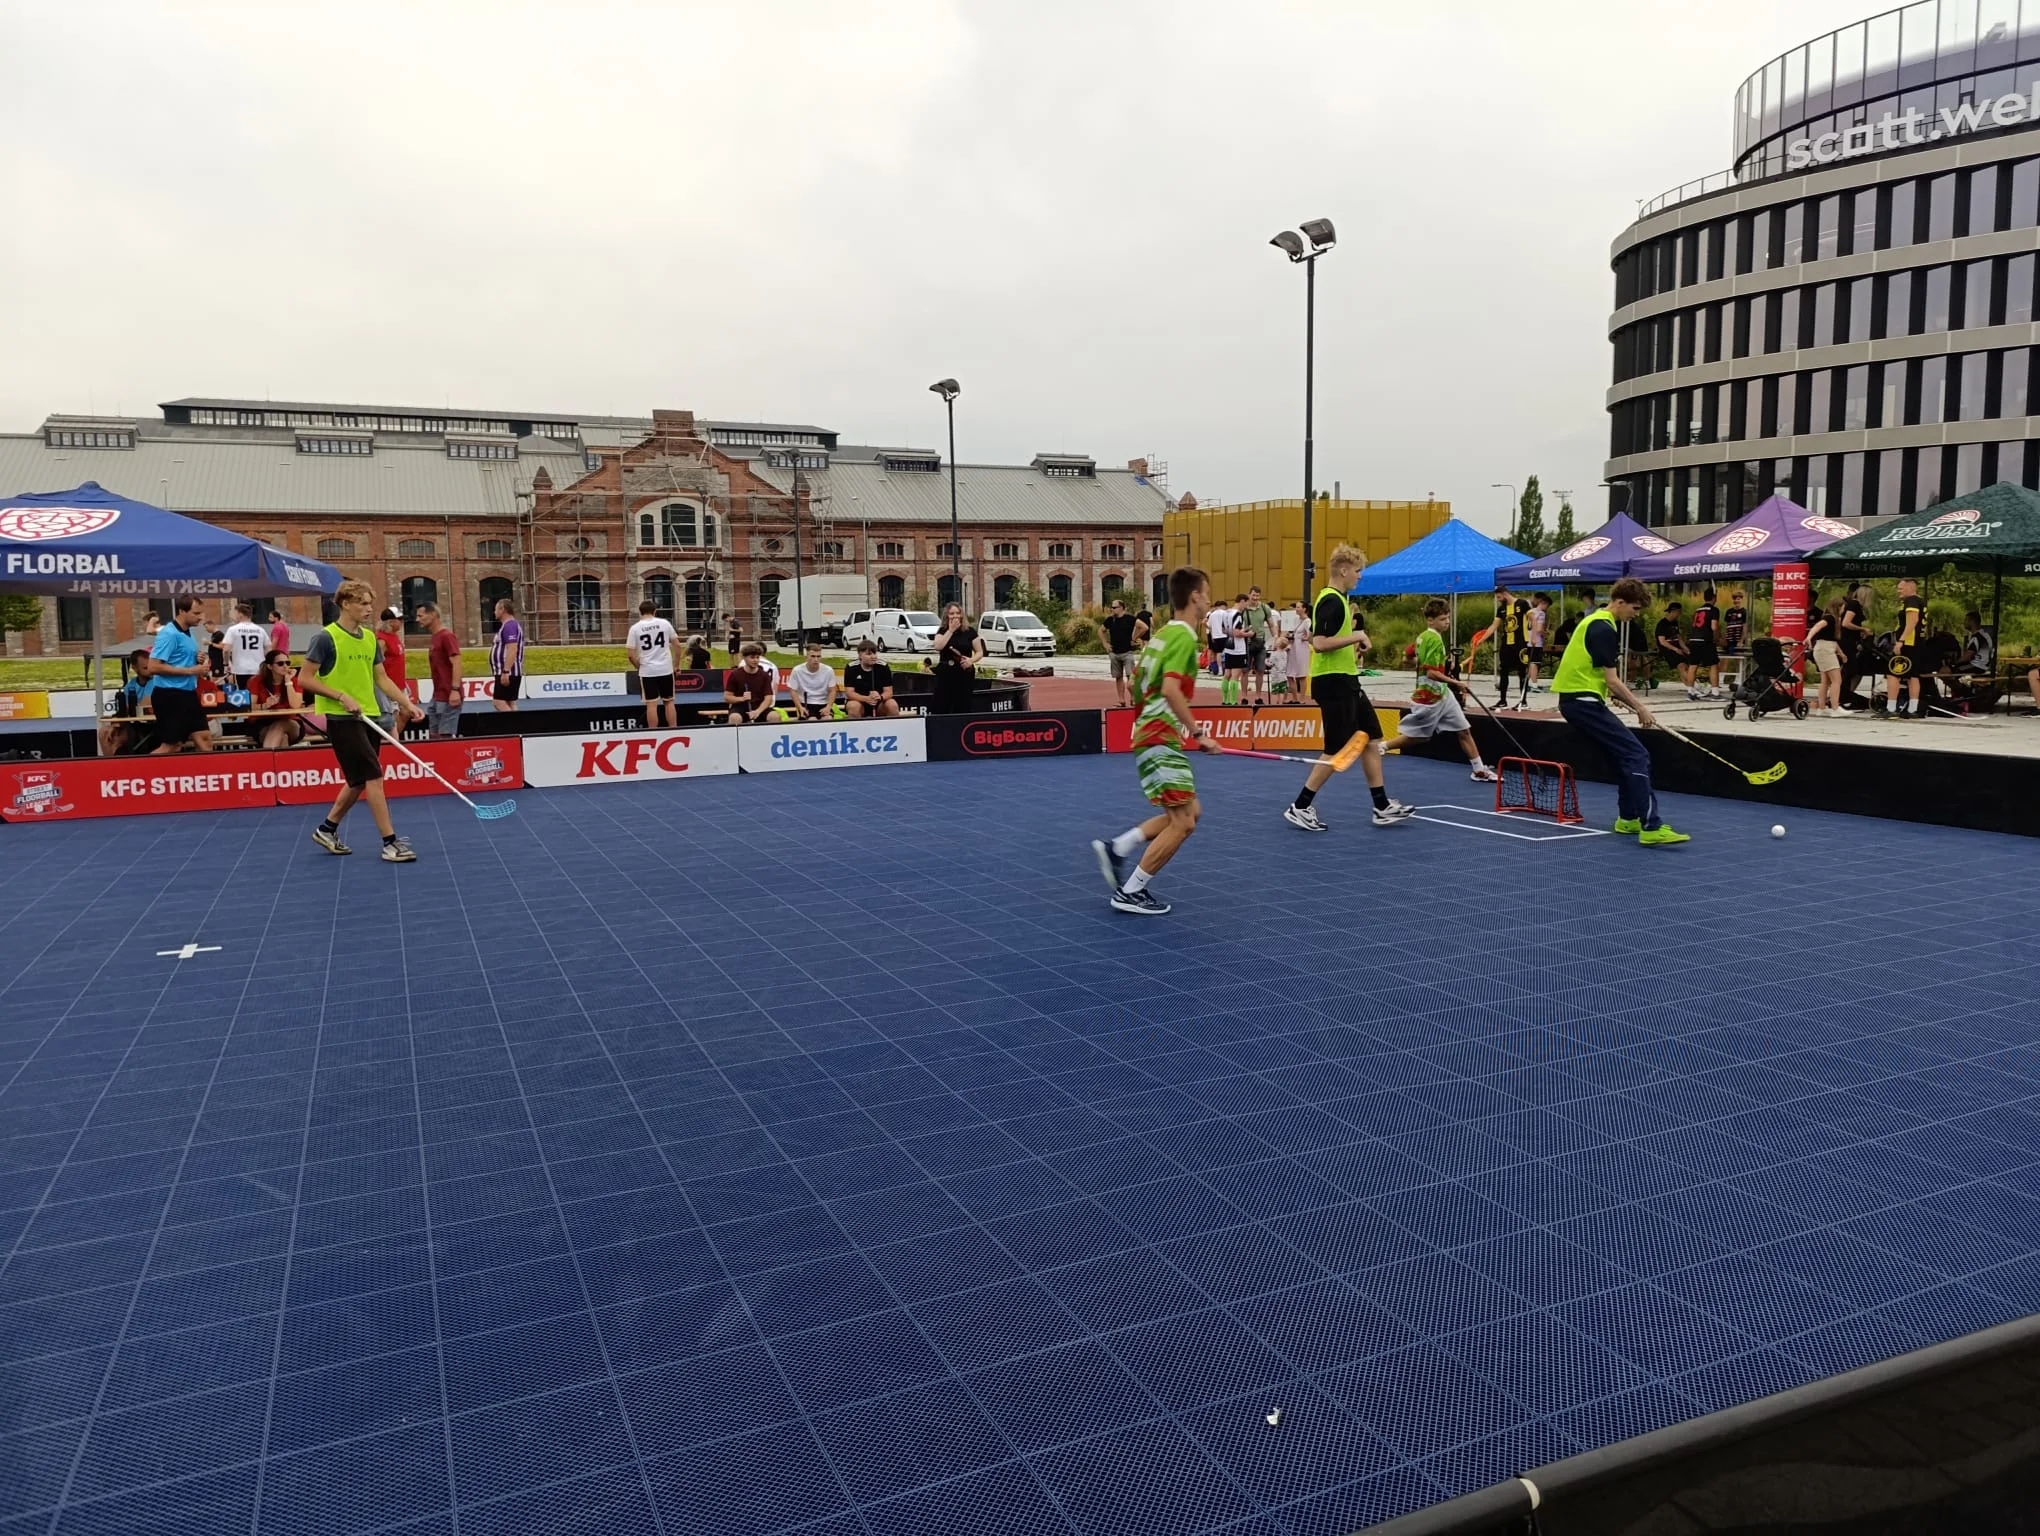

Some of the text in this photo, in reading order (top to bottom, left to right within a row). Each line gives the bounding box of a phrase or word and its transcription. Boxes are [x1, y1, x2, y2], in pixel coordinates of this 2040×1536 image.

[1880, 522, 1992, 541] HOLBA
[7, 553, 126, 574] FLORBAL
[1529, 567, 1581, 578] ČESKÝ FLORBAL
[1674, 562, 1741, 575] ČESKÝ FLORBAL
[1786, 572, 1807, 580] KFC
[241, 635, 259, 650] 12
[639, 631, 667, 651] 34
[974, 728, 1056, 748] BigBoard
[1215, 720, 1250, 738] LIKE
[1253, 719, 1315, 738] WOMEN
[770, 732, 898, 759] deník.cz
[576, 736, 691, 778] KFC
[101, 778, 146, 798] KFC
[150, 774, 233, 795] STREET
